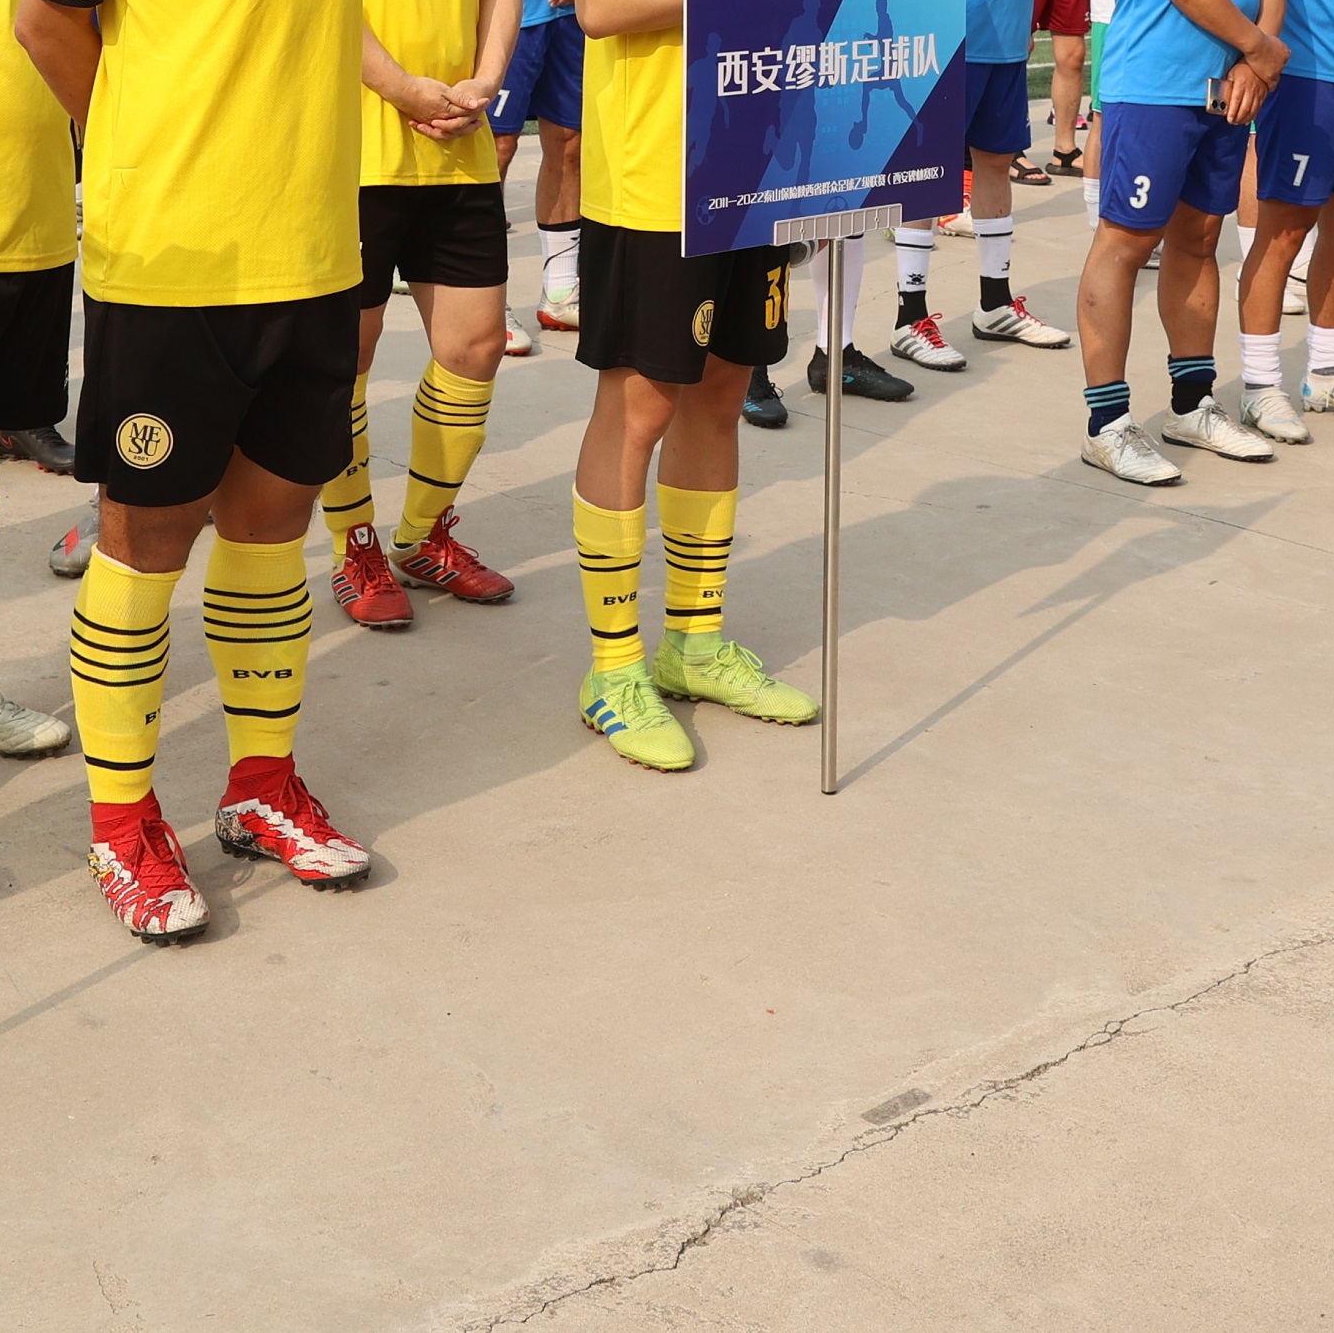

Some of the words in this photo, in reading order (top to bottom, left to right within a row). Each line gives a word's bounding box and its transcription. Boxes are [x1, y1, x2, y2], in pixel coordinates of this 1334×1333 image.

[717, 33, 940, 97] 西安缪斯足球队
[1292, 153, 1310, 187] 7
[1129, 175, 1151, 209] 3
[765, 266, 789, 330] 3
[129, 421, 162, 443] ME
[128, 437, 160, 457] SU
[603, 591, 637, 606] BVB
[232, 669, 293, 679] BVB
